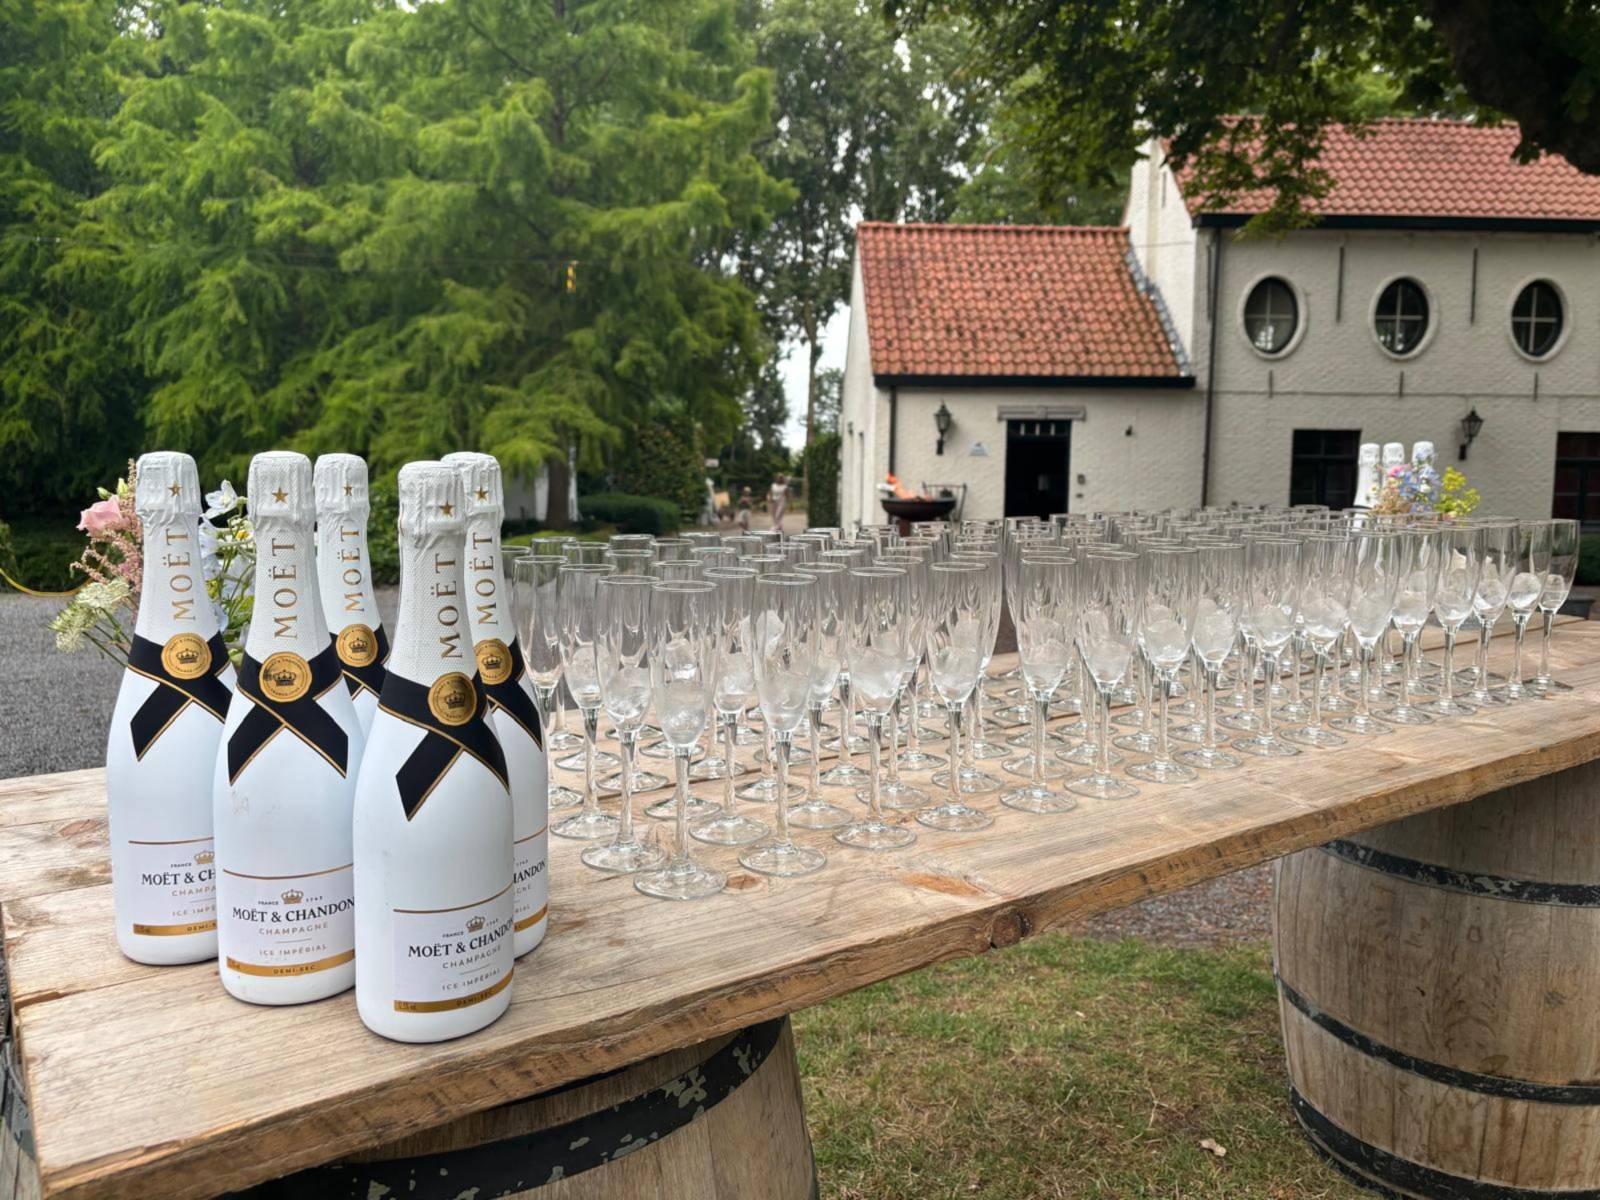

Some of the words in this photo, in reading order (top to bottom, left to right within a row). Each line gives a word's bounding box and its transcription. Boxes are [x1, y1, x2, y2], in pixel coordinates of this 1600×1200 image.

[162, 528, 196, 621] MOËT
[337, 525, 365, 612] MOËT
[469, 532, 498, 626] MOËT
[268, 537, 298, 639] MOËT
[430, 553, 463, 660] MOËT
[141, 871, 181, 886] MOËT
[184, 872, 195, 884] &
[171, 886, 216, 897] CHAMPA
[232, 906, 268, 922] MOËT
[271, 911, 282, 923] &
[285, 896, 355, 922] CHANDON
[259, 922, 329, 935] CHAMPAGNE
[408, 942, 453, 958] MOËT
[455, 941, 466, 954] &
[442, 944, 501, 969] CHAMPAGNE
[442, 983, 458, 991] ICE
